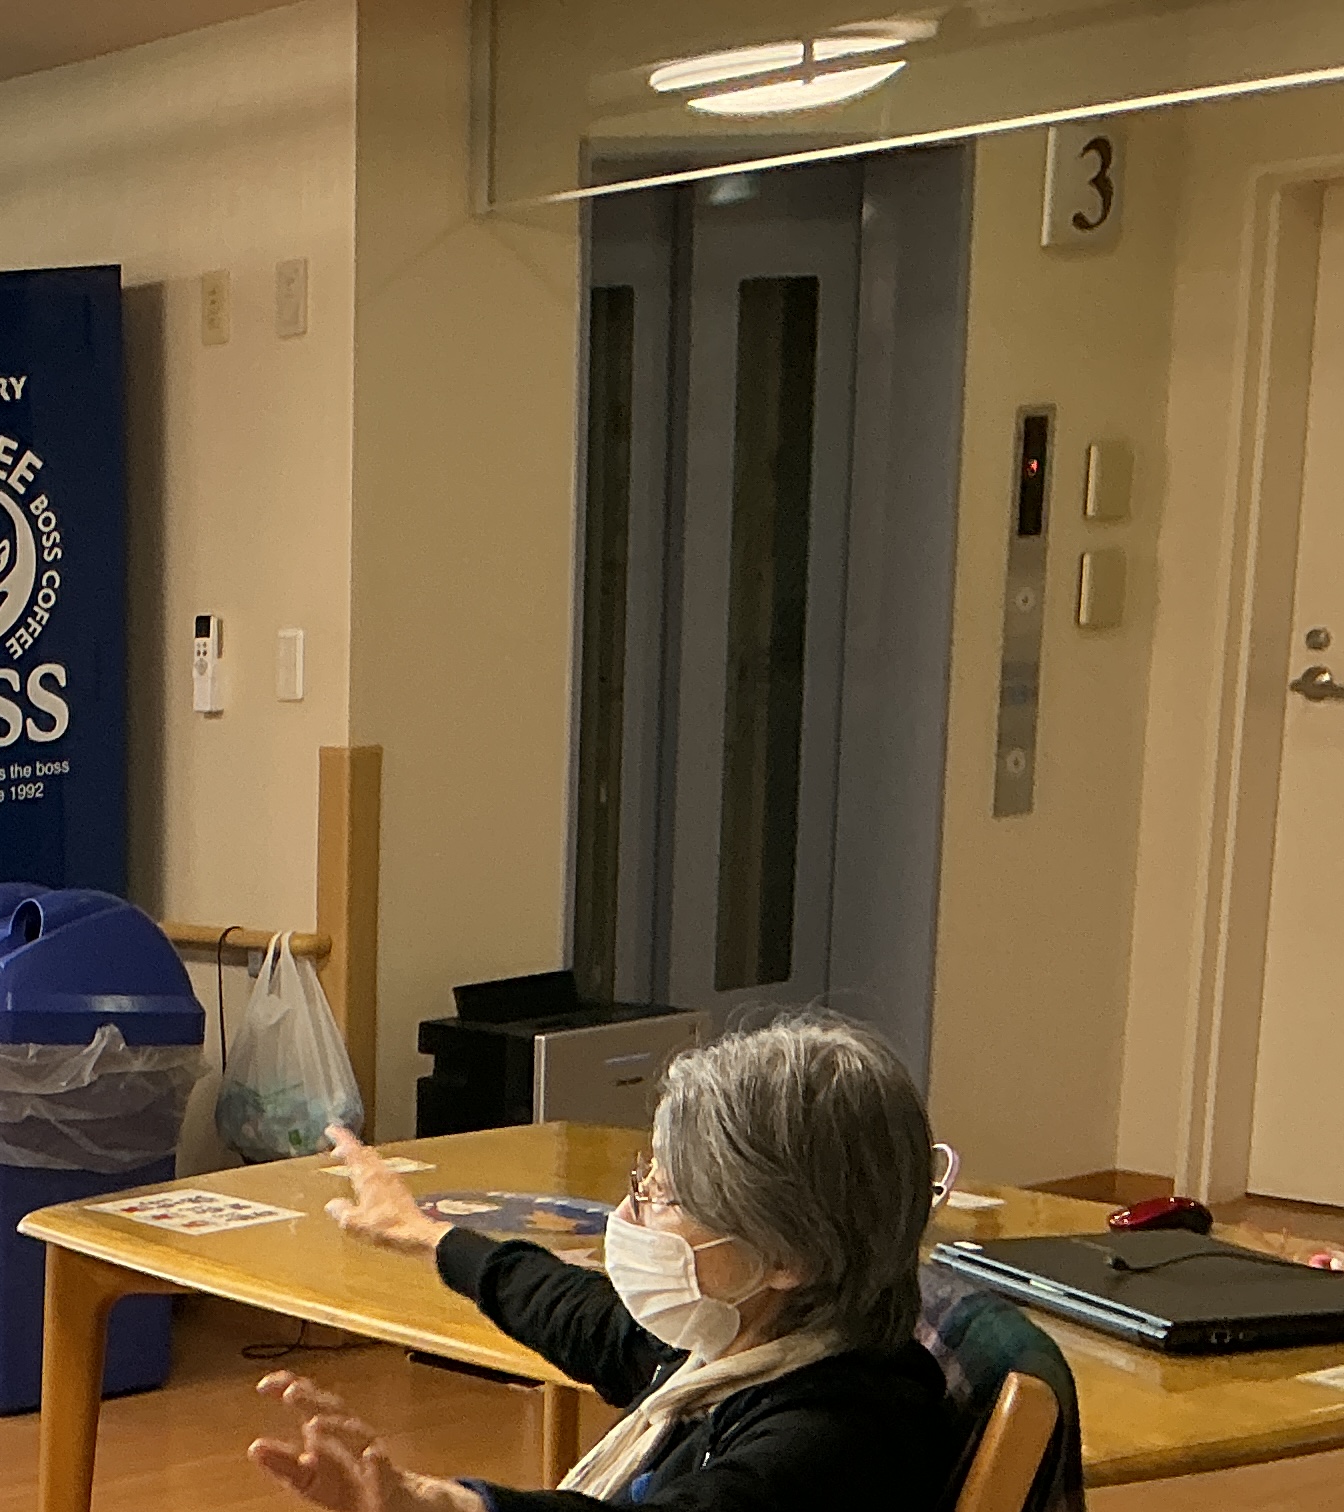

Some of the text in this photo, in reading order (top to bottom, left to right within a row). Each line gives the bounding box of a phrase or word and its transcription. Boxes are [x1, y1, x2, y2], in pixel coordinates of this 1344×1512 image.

[1071, 135, 1114, 233] 3
[5, 494, 63, 660] BOSS COFFEE
[9, 763, 32, 780] the
[36, 760, 70, 776] boss
[10, 782, 44, 801] 1992
